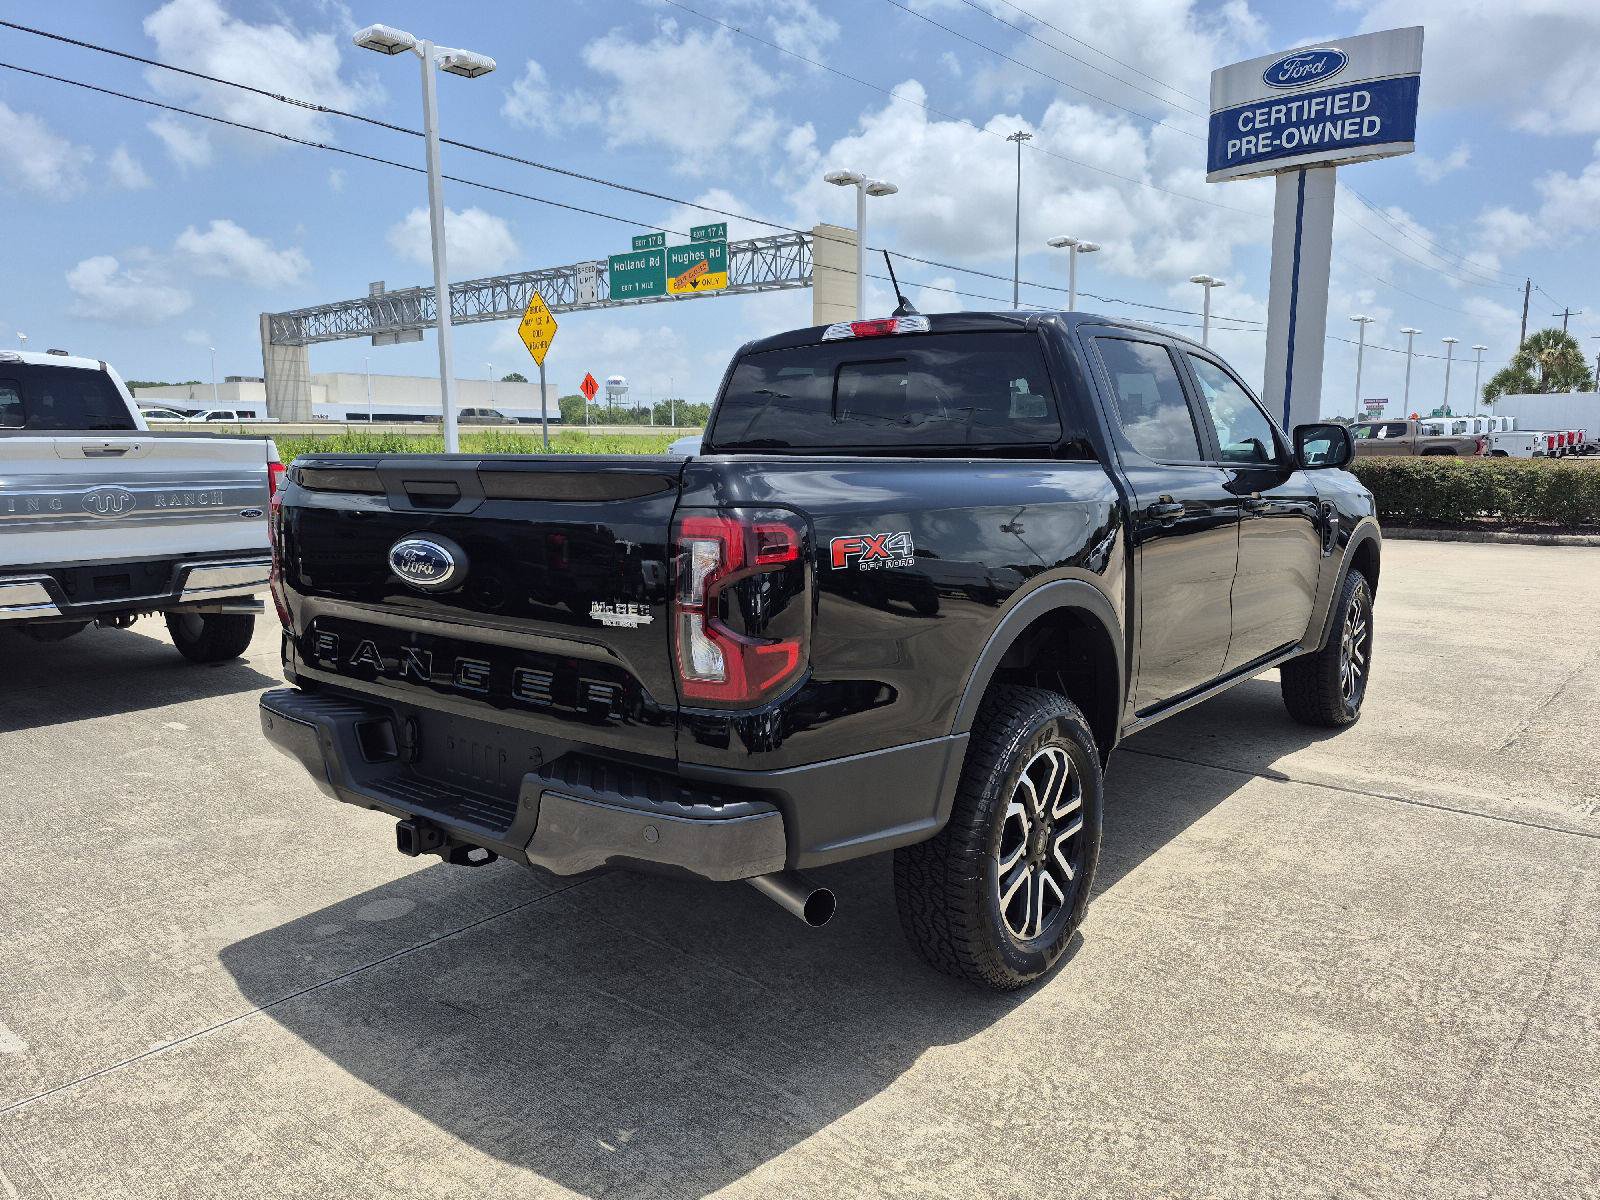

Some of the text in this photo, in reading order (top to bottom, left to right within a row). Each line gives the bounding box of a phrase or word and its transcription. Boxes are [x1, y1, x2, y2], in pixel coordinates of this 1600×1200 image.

[1278, 54, 1327, 81] Ford
[1237, 90, 1371, 132] CERTIFIED
[1227, 115, 1381, 160] PRE-OWNED
[635, 239, 646, 247] EXIT
[693, 230, 705, 238] EXIT
[614, 256, 660, 272] Holland Rd
[671, 247, 721, 265] Hughes Rd
[621, 281, 654, 292] EXIT 1 MILE
[701, 278, 720, 286] ONLY
[7, 491, 223, 512] ING RANCH
[829, 531, 915, 571] FX4
[401, 549, 436, 575] Ford
[859, 557, 915, 572] OFF ROAD
[312, 628, 626, 720] RANGER
